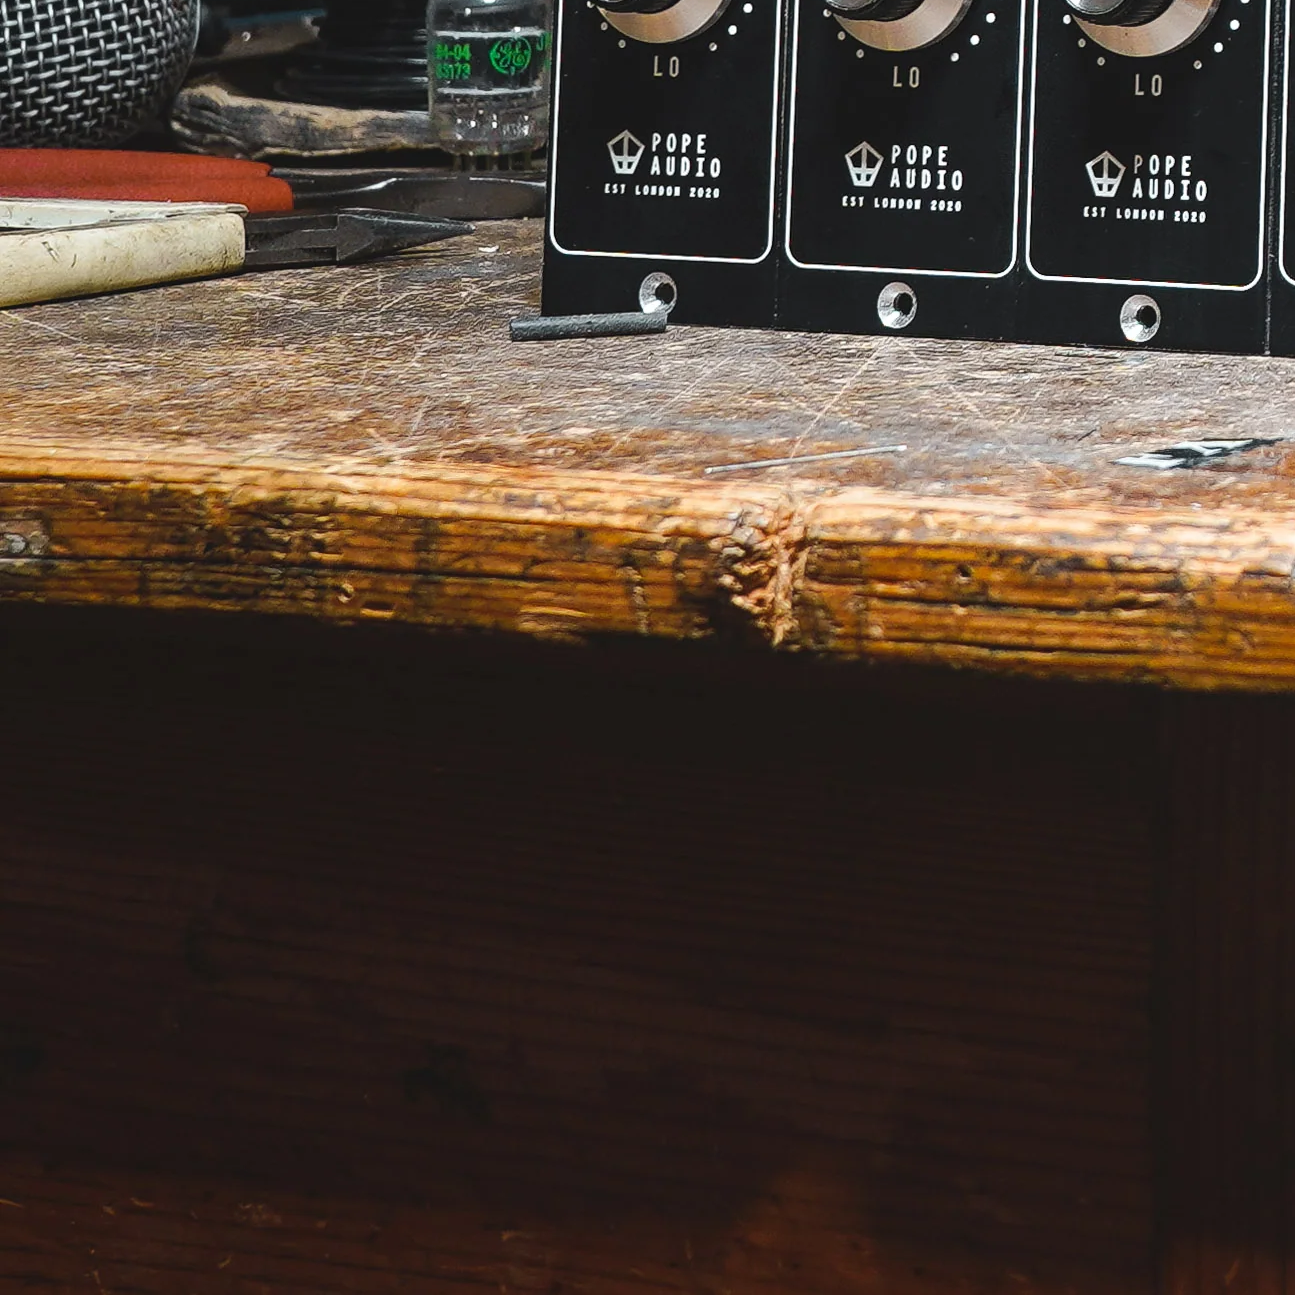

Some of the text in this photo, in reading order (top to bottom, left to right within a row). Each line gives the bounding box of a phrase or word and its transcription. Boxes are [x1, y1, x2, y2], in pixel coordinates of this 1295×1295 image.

[653, 55, 680, 78] LO
[892, 65, 920, 89] LO
[1134, 73, 1163, 97] LO
[651, 132, 707, 155] POPE
[891, 144, 949, 167] POPE
[650, 155, 721, 179] AUDIO
[1134, 154, 1192, 177] POPE
[889, 167, 963, 191] AUDIO
[1132, 177, 1208, 202] AUDIO
